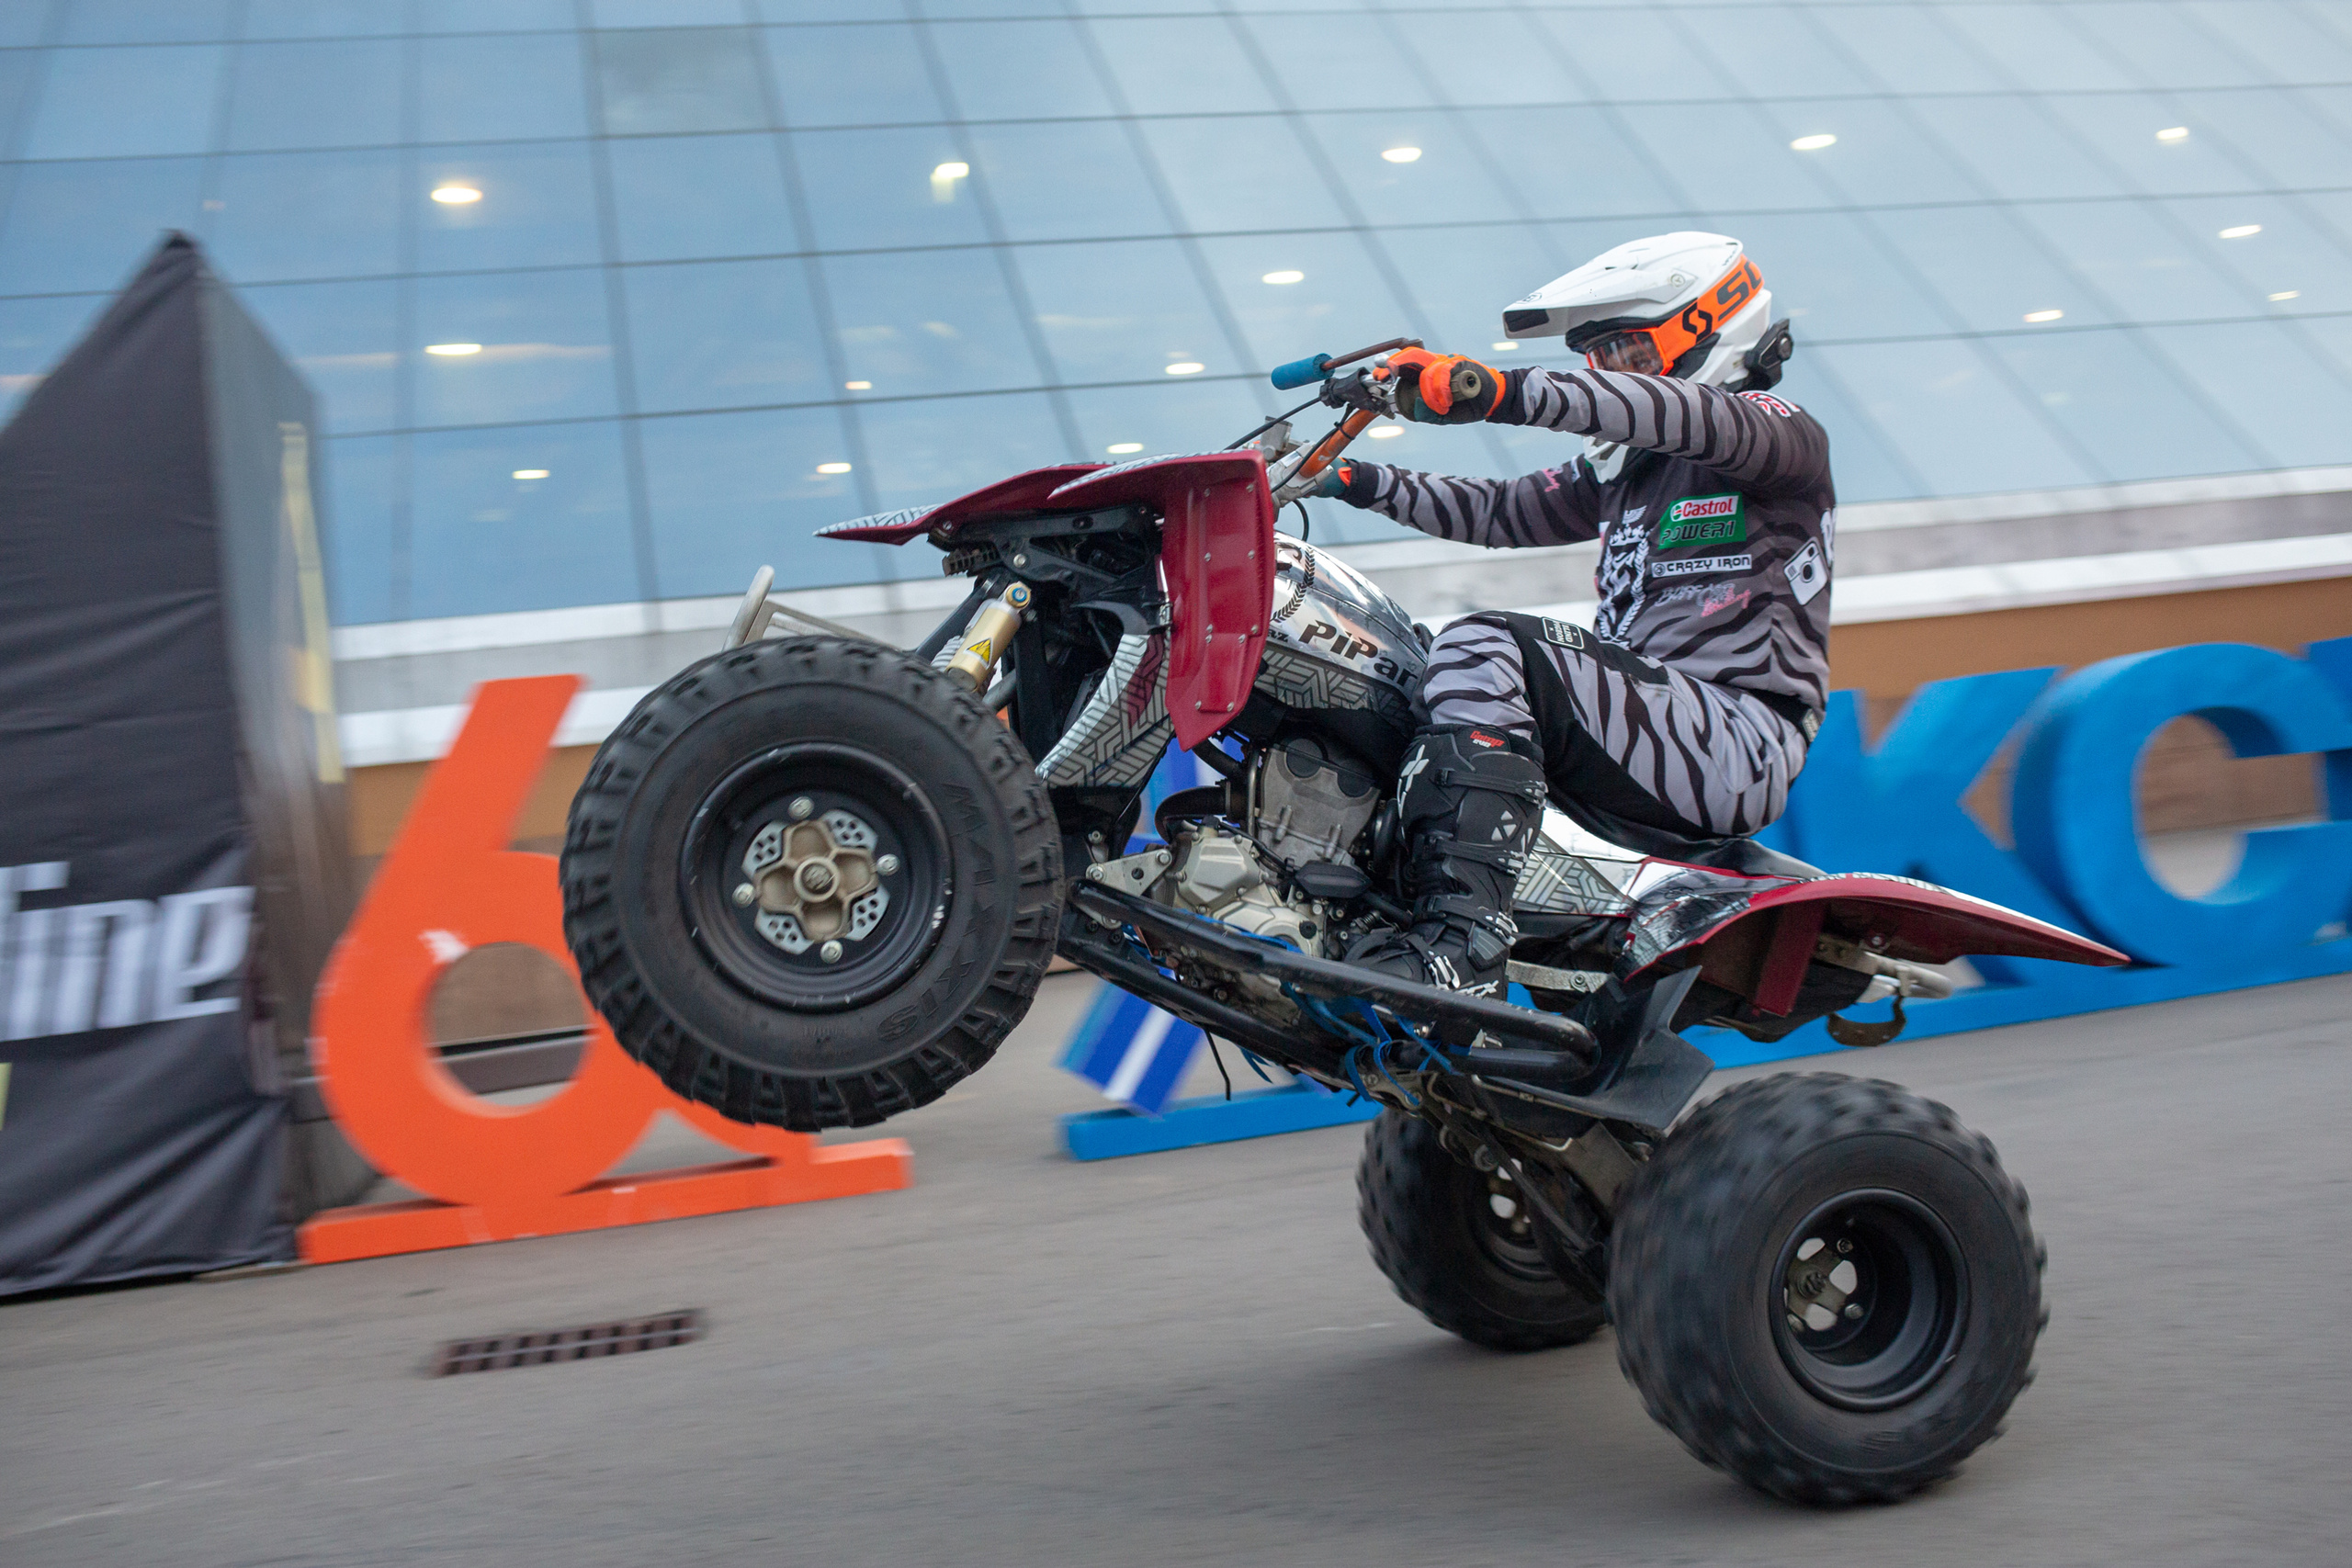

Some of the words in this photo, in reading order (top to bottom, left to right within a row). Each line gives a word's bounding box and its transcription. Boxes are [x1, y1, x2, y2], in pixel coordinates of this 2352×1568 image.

[1682, 497, 1734, 517] Castrol
[1660, 520, 1736, 545] POWER1
[1666, 558, 1713, 572] CRAZY
[1717, 557, 1750, 570] IRON
